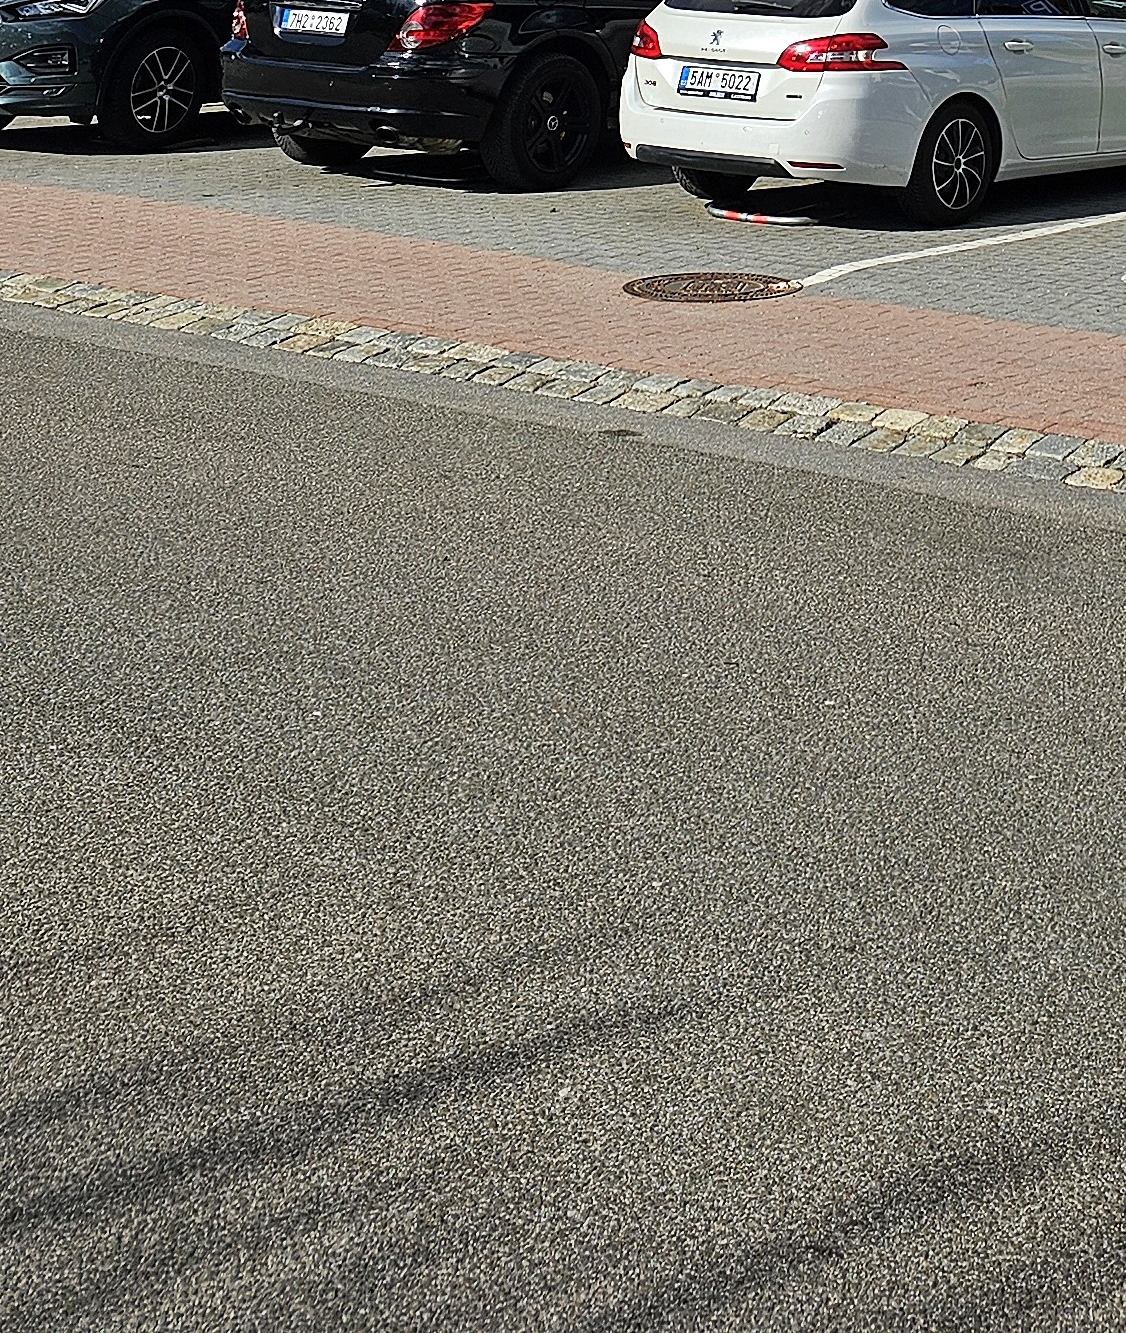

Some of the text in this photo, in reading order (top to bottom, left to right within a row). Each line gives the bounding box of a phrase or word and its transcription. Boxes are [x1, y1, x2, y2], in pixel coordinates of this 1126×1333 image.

[289, 12, 343, 32] 7H2 2362
[689, 70, 752, 91] 5AM 5022
